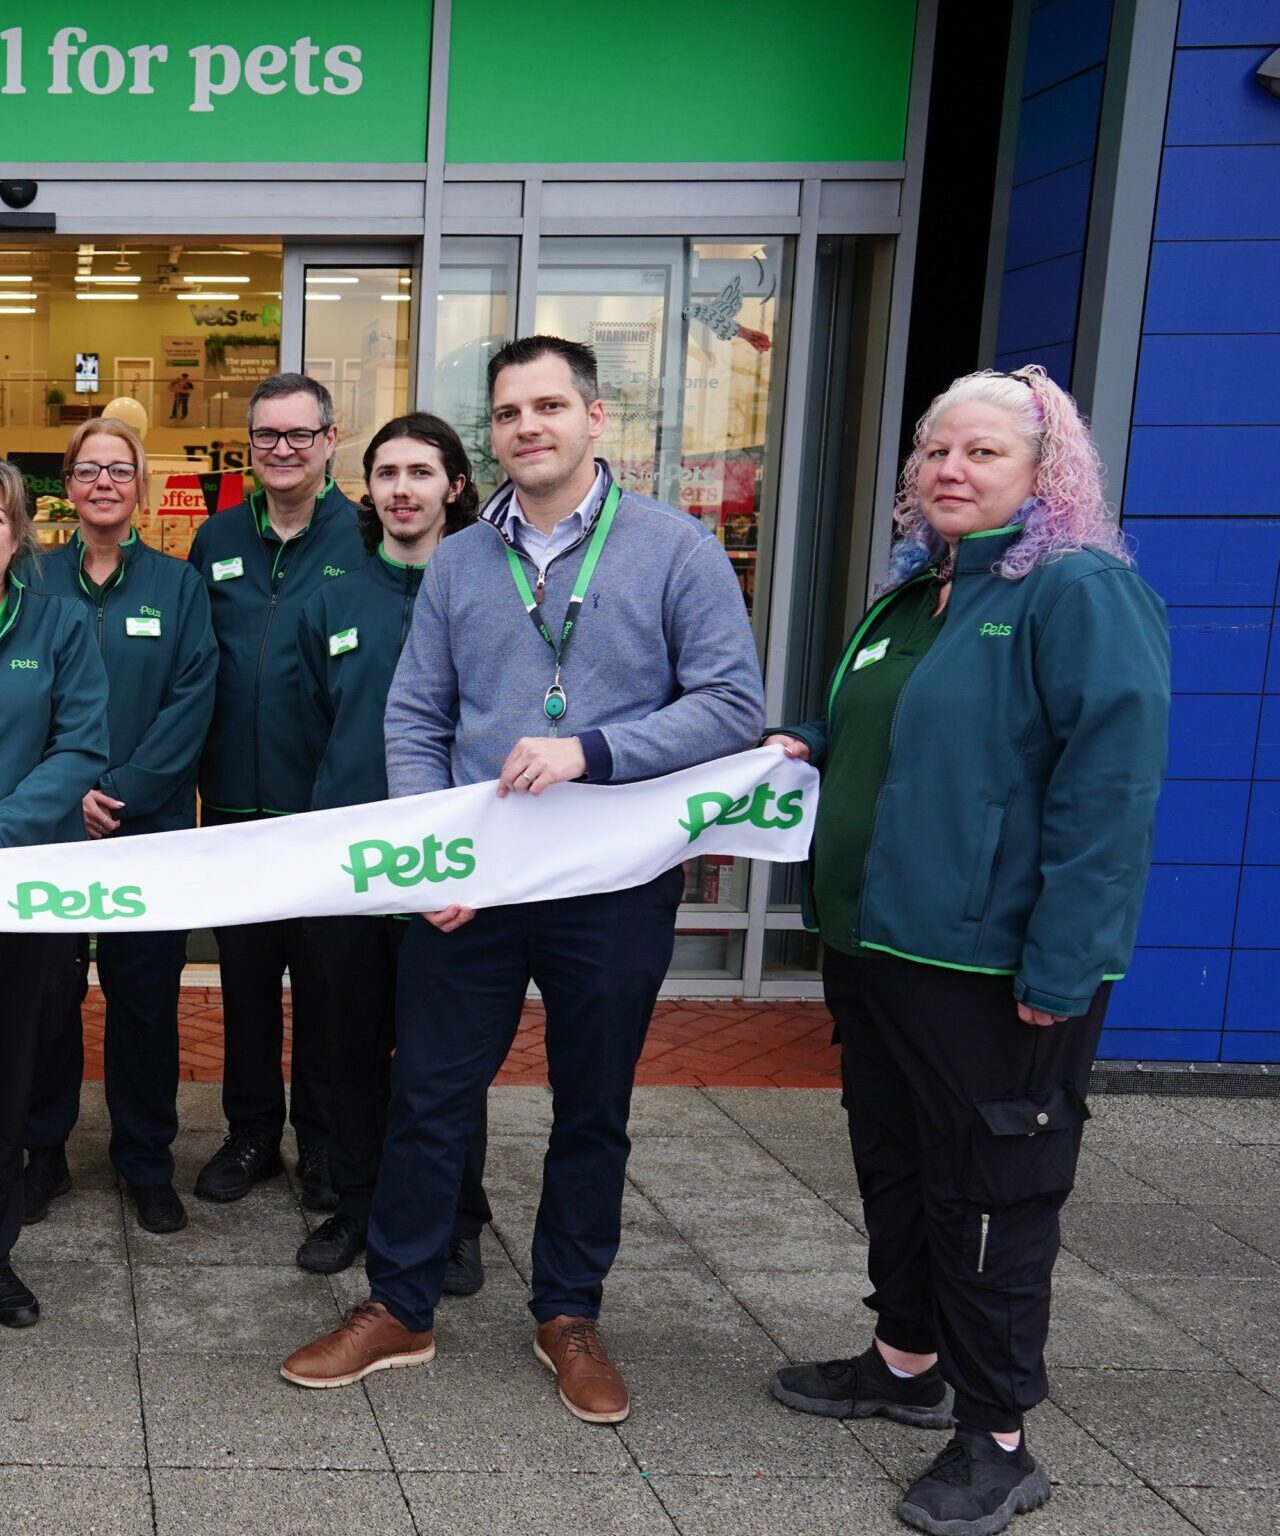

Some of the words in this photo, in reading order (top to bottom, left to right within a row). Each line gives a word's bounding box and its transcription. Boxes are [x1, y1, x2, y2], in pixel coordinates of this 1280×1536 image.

[48, 26, 168, 95] for
[189, 36, 364, 112] pets
[190, 304, 238, 326] Vets
[240, 311, 259, 322] for
[257, 304, 281, 327] P
[594, 330, 651, 343] WARNING!
[159, 490, 207, 507] offer
[979, 622, 1012, 637] Pets
[9, 658, 39, 670] Pets
[678, 782, 804, 843] Pets
[341, 833, 476, 893] Pets
[7, 880, 146, 920] Pets
